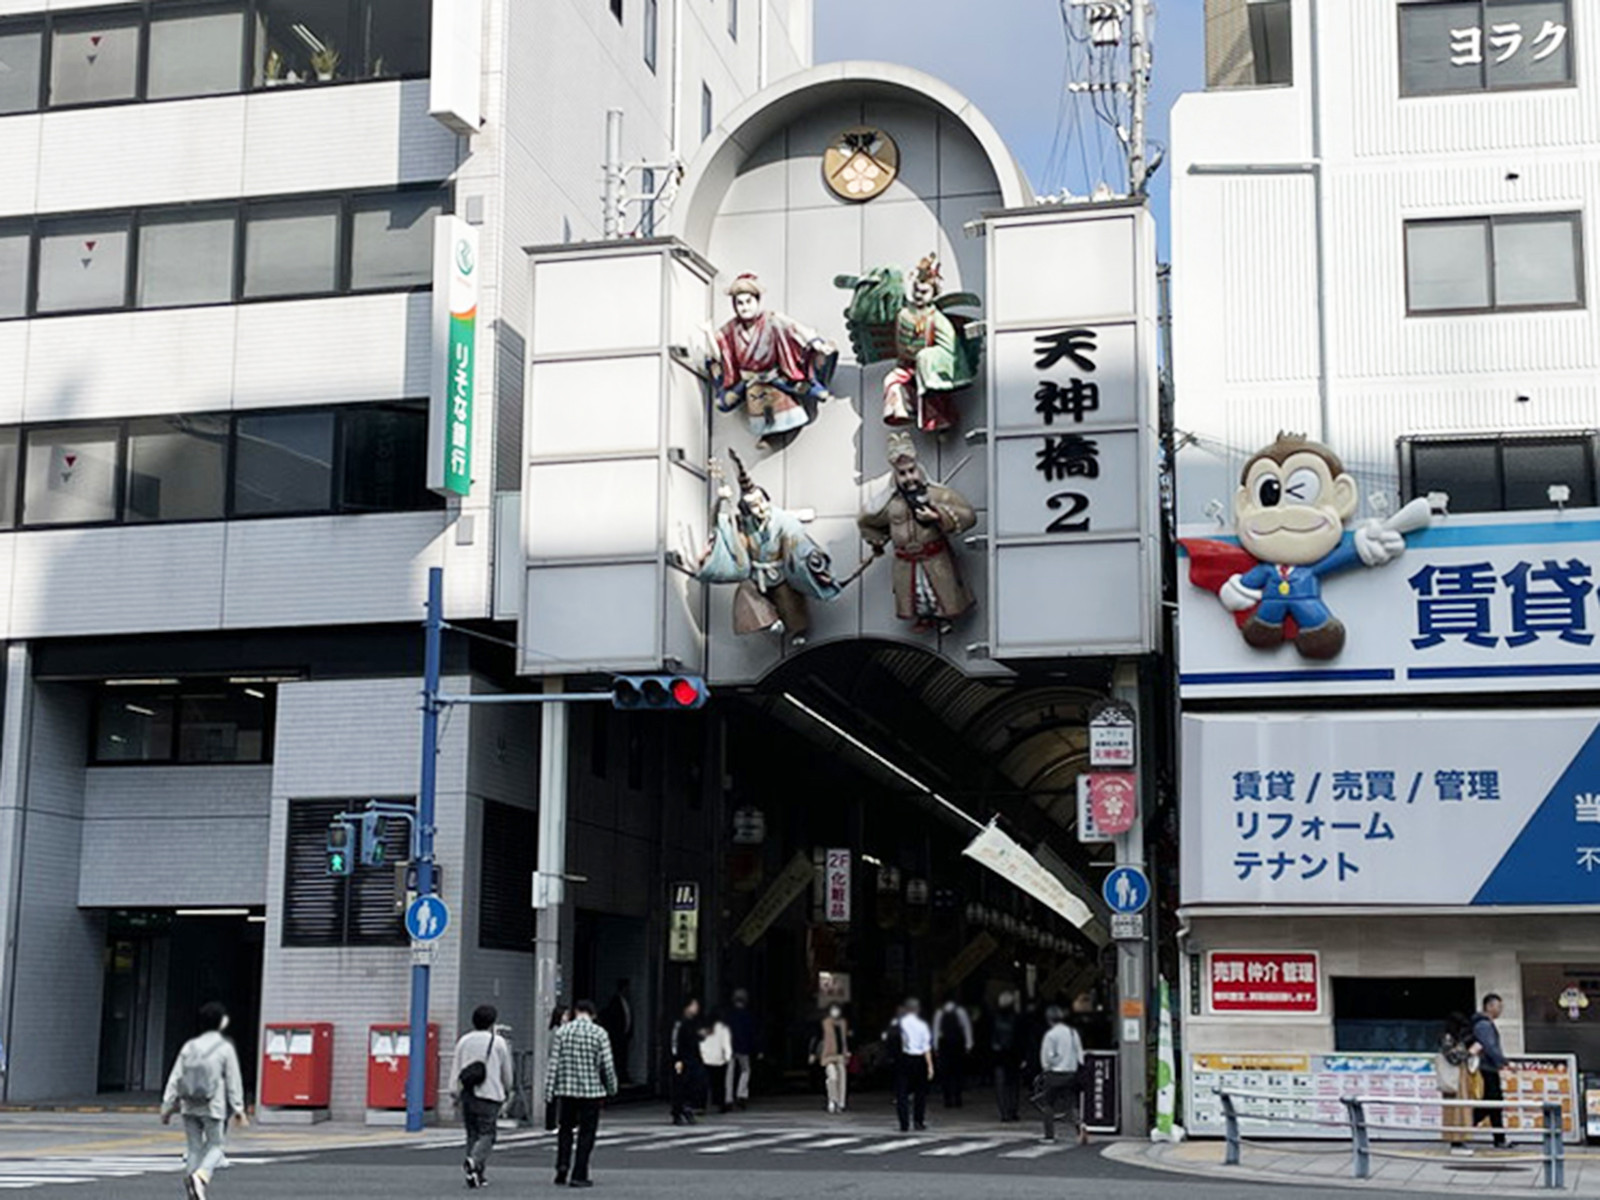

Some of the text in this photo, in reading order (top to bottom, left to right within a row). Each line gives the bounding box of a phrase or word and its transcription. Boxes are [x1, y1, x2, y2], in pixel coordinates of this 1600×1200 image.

[1450, 20, 1567, 65] ヨラク
[1033, 328, 1099, 533] 天神橋2
[1408, 558, 1600, 650] 賃貸
[1232, 769, 1500, 804] 賃貸 / 売買 / 管理
[1237, 811, 1395, 841] リフォーム
[830, 853, 849, 869] 2F
[1234, 852, 1360, 882] テナント
[1577, 847, 1600, 873] 不
[831, 871, 847, 918] 化粧品
[1213, 961, 1315, 983] 売買 仲介 管理
